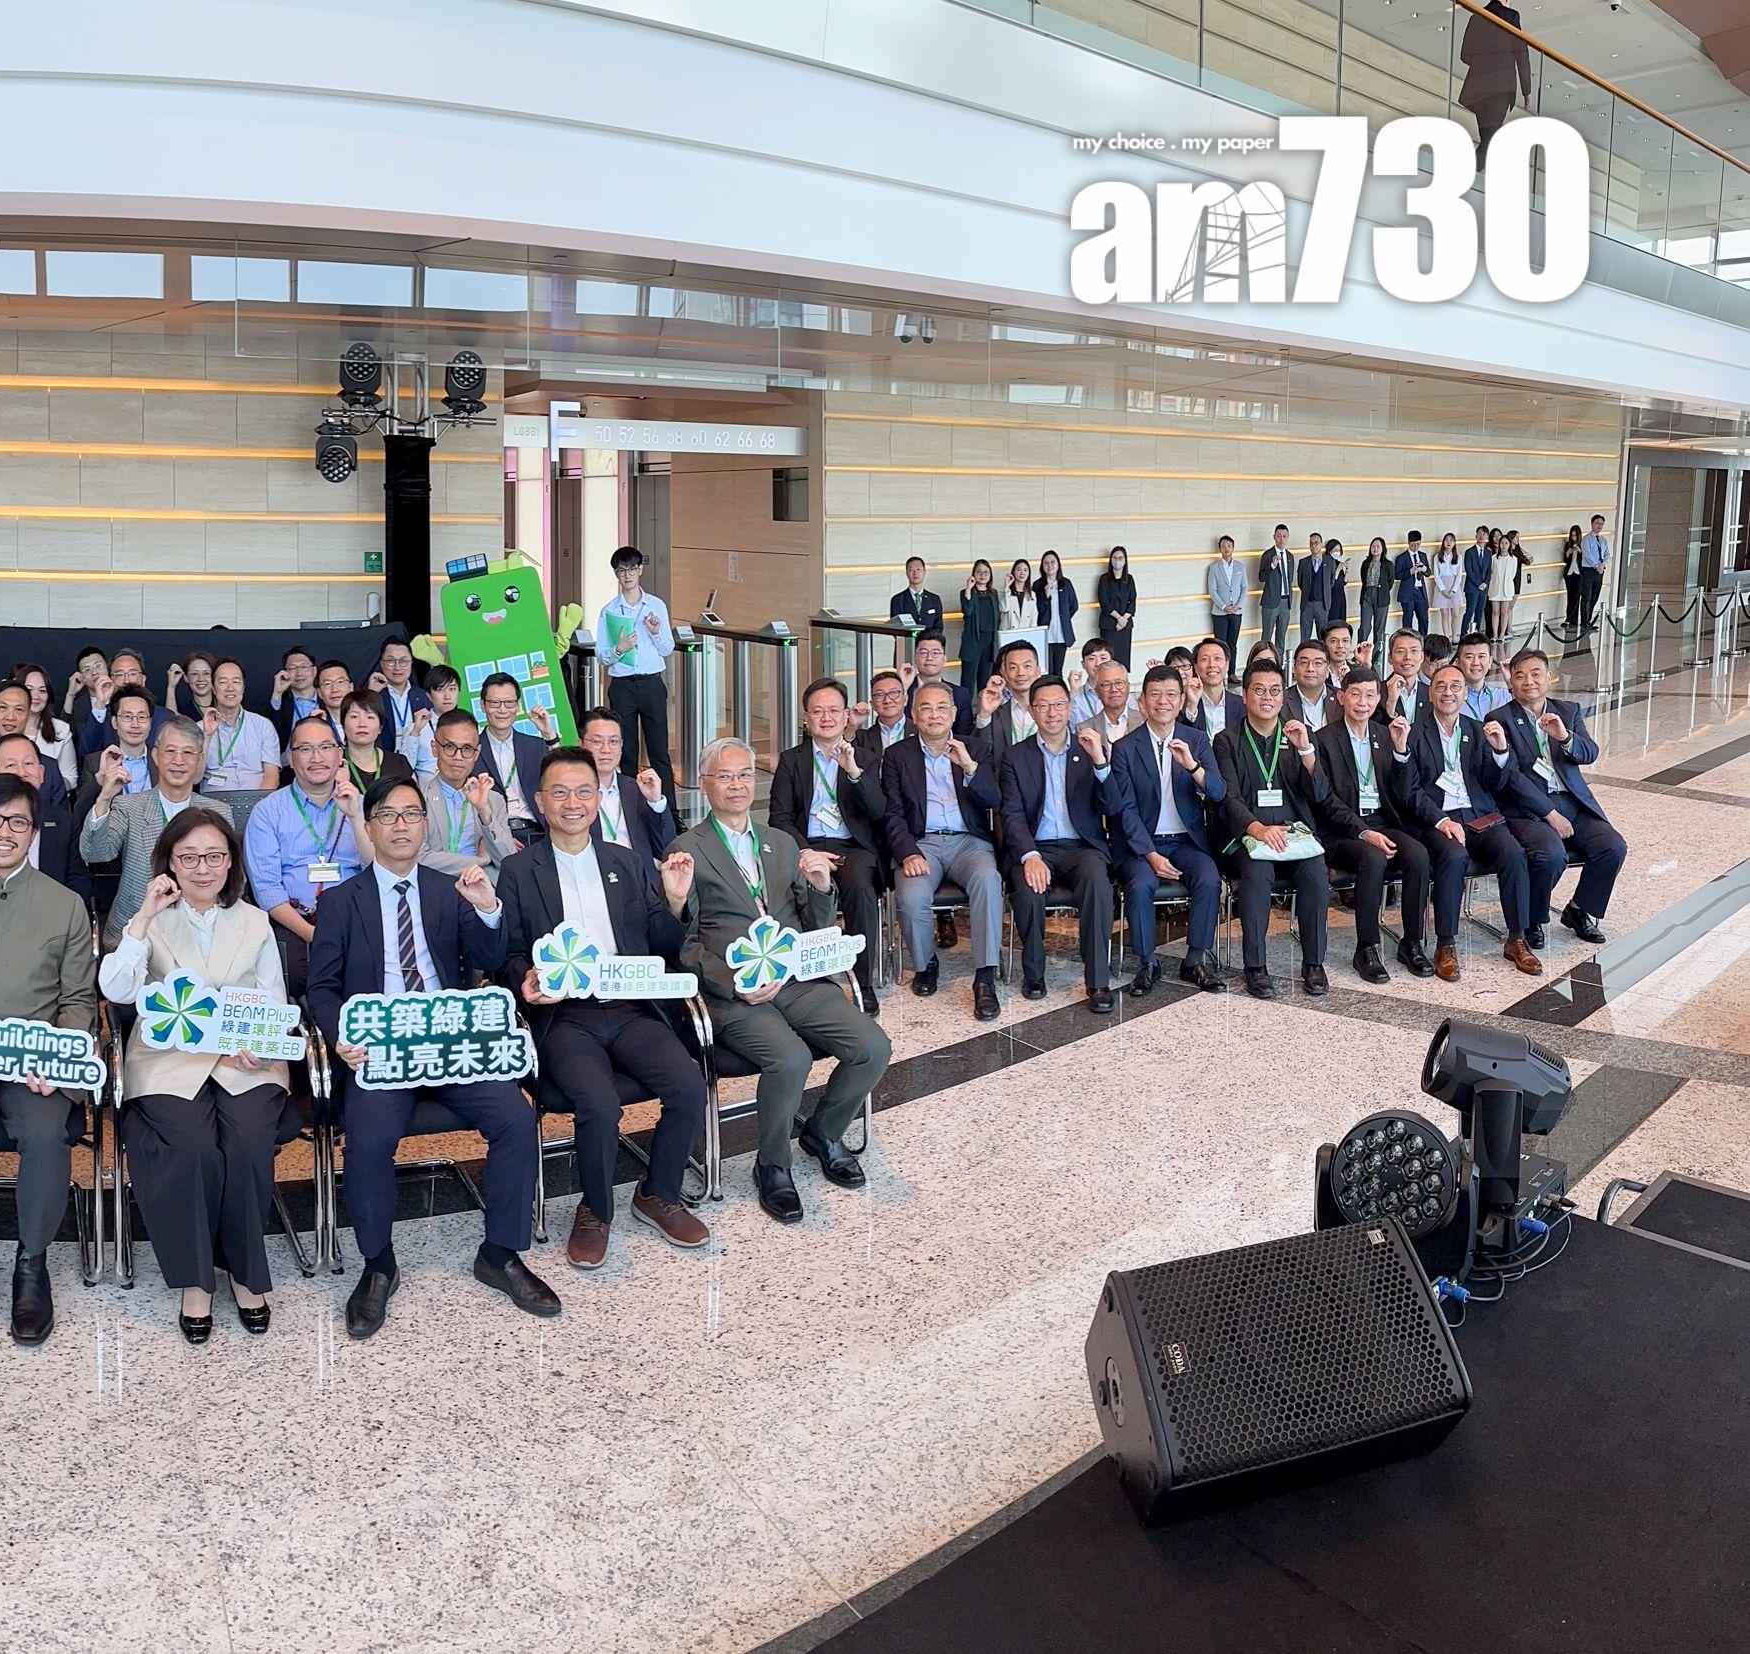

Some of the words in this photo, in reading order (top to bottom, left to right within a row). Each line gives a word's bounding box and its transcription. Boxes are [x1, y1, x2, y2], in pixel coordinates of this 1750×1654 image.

[550, 401, 581, 462] F
[595, 426, 612, 442] 50
[618, 426, 635, 444] 52
[643, 428, 660, 444] 56
[666, 428, 683, 445] 58
[691, 430, 708, 446] 60
[714, 430, 730, 447] 62
[737, 431, 753, 448] 66
[760, 432, 776, 448] 68
[801, 931, 837, 948] HKGBC
[801, 943, 837, 962] BEAM
[838, 939, 862, 953] Plus
[600, 963, 658, 979] HKGBC
[800, 954, 852, 976] 綠建環評
[226, 992, 267, 1005] HKGBC
[223, 1004, 265, 1020] BEAM
[267, 1008, 295, 1023] Plus
[350, 998, 506, 1041] 共築綠建
[220, 1021, 281, 1037] 綠建環評
[282, 1043, 300, 1056] EB
[367, 1036, 523, 1080] 點亮未來
[23, 1055, 99, 1082] Future
